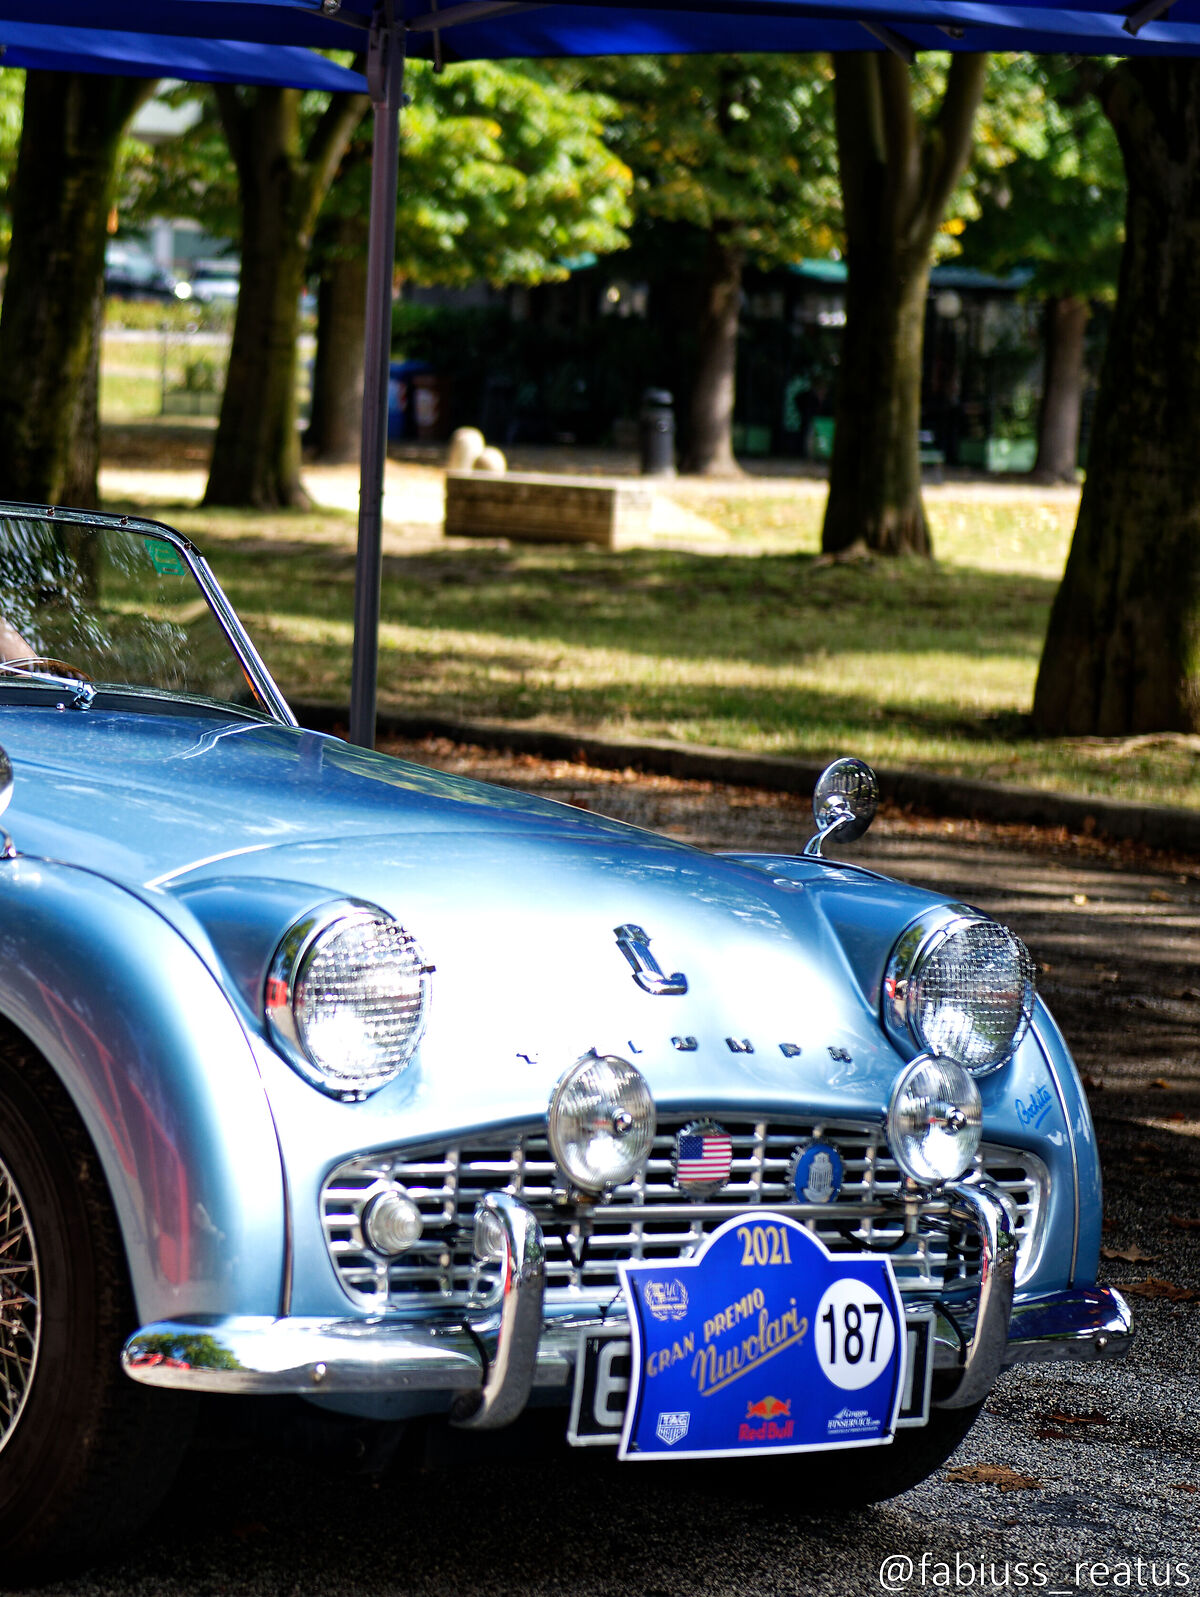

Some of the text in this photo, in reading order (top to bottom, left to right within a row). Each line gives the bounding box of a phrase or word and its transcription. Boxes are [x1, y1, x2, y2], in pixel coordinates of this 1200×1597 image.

[737, 1226, 792, 1266] 2021
[646, 1331, 695, 1377] GRAN
[703, 1287, 765, 1343] PREMIO
[690, 1297, 804, 1393] Nuvolari
[822, 1303, 883, 1365] 187
[738, 1420, 794, 1442] Red Bull
